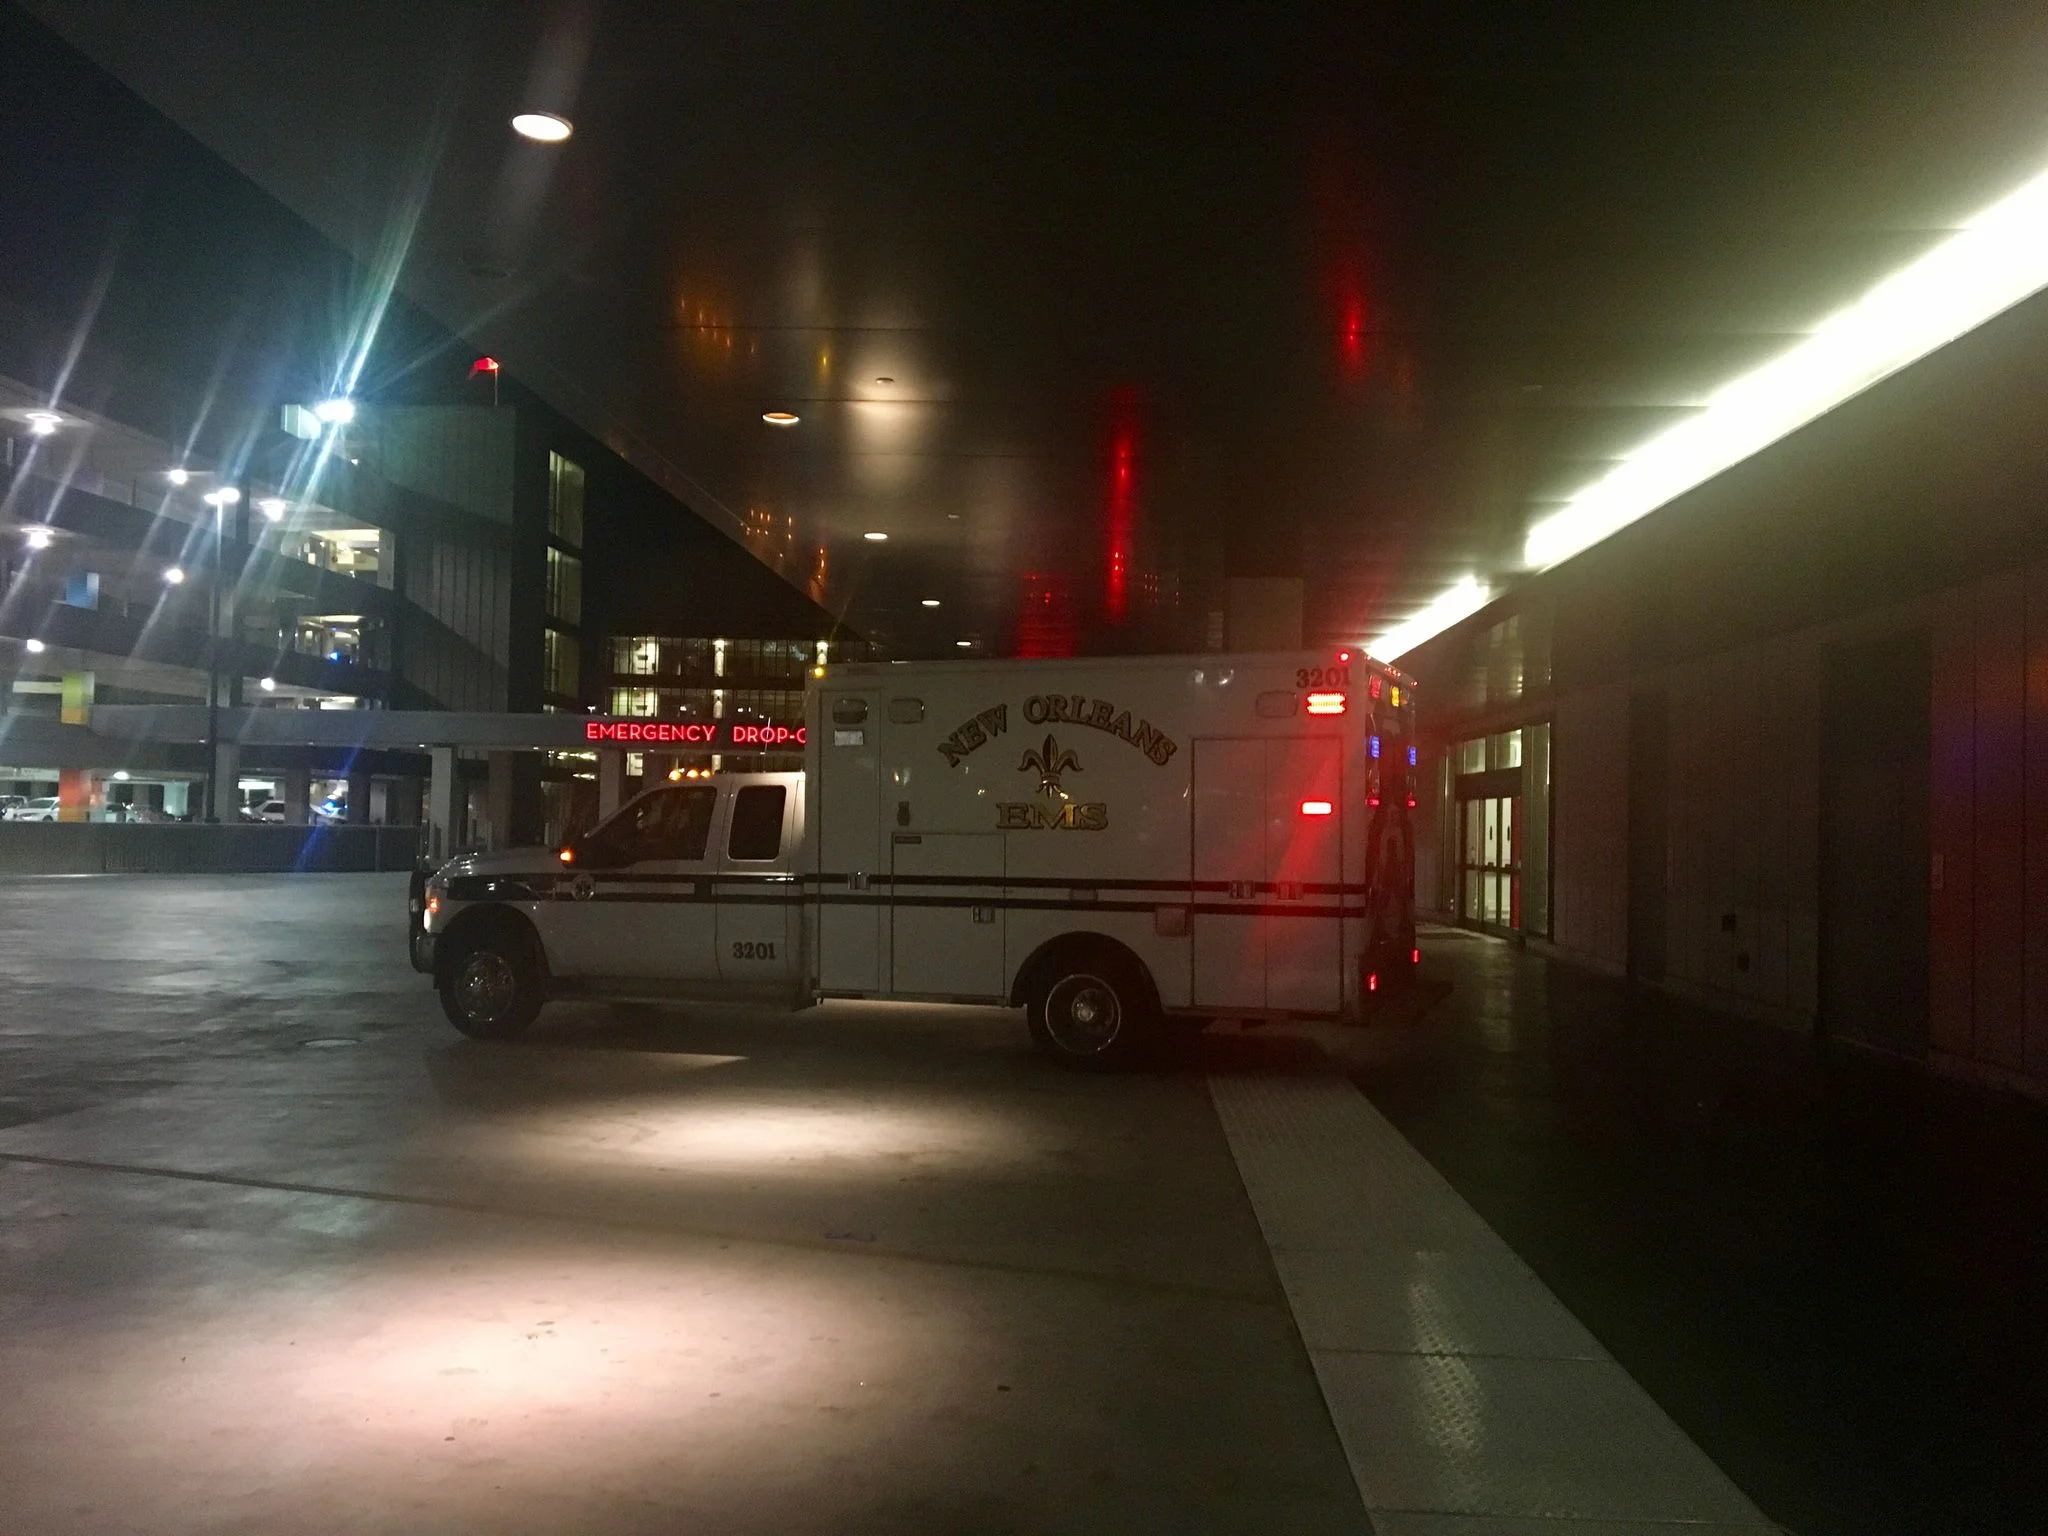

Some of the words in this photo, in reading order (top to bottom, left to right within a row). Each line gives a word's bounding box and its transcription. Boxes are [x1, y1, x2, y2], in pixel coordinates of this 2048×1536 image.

[1297, 667, 1352, 688] 3201
[586, 722, 716, 742] EMERGENCY
[937, 704, 1008, 768] NEW
[1022, 695, 1178, 766] ORLEANS
[994, 801, 1109, 831] EMS
[732, 942, 777, 961] 3201
